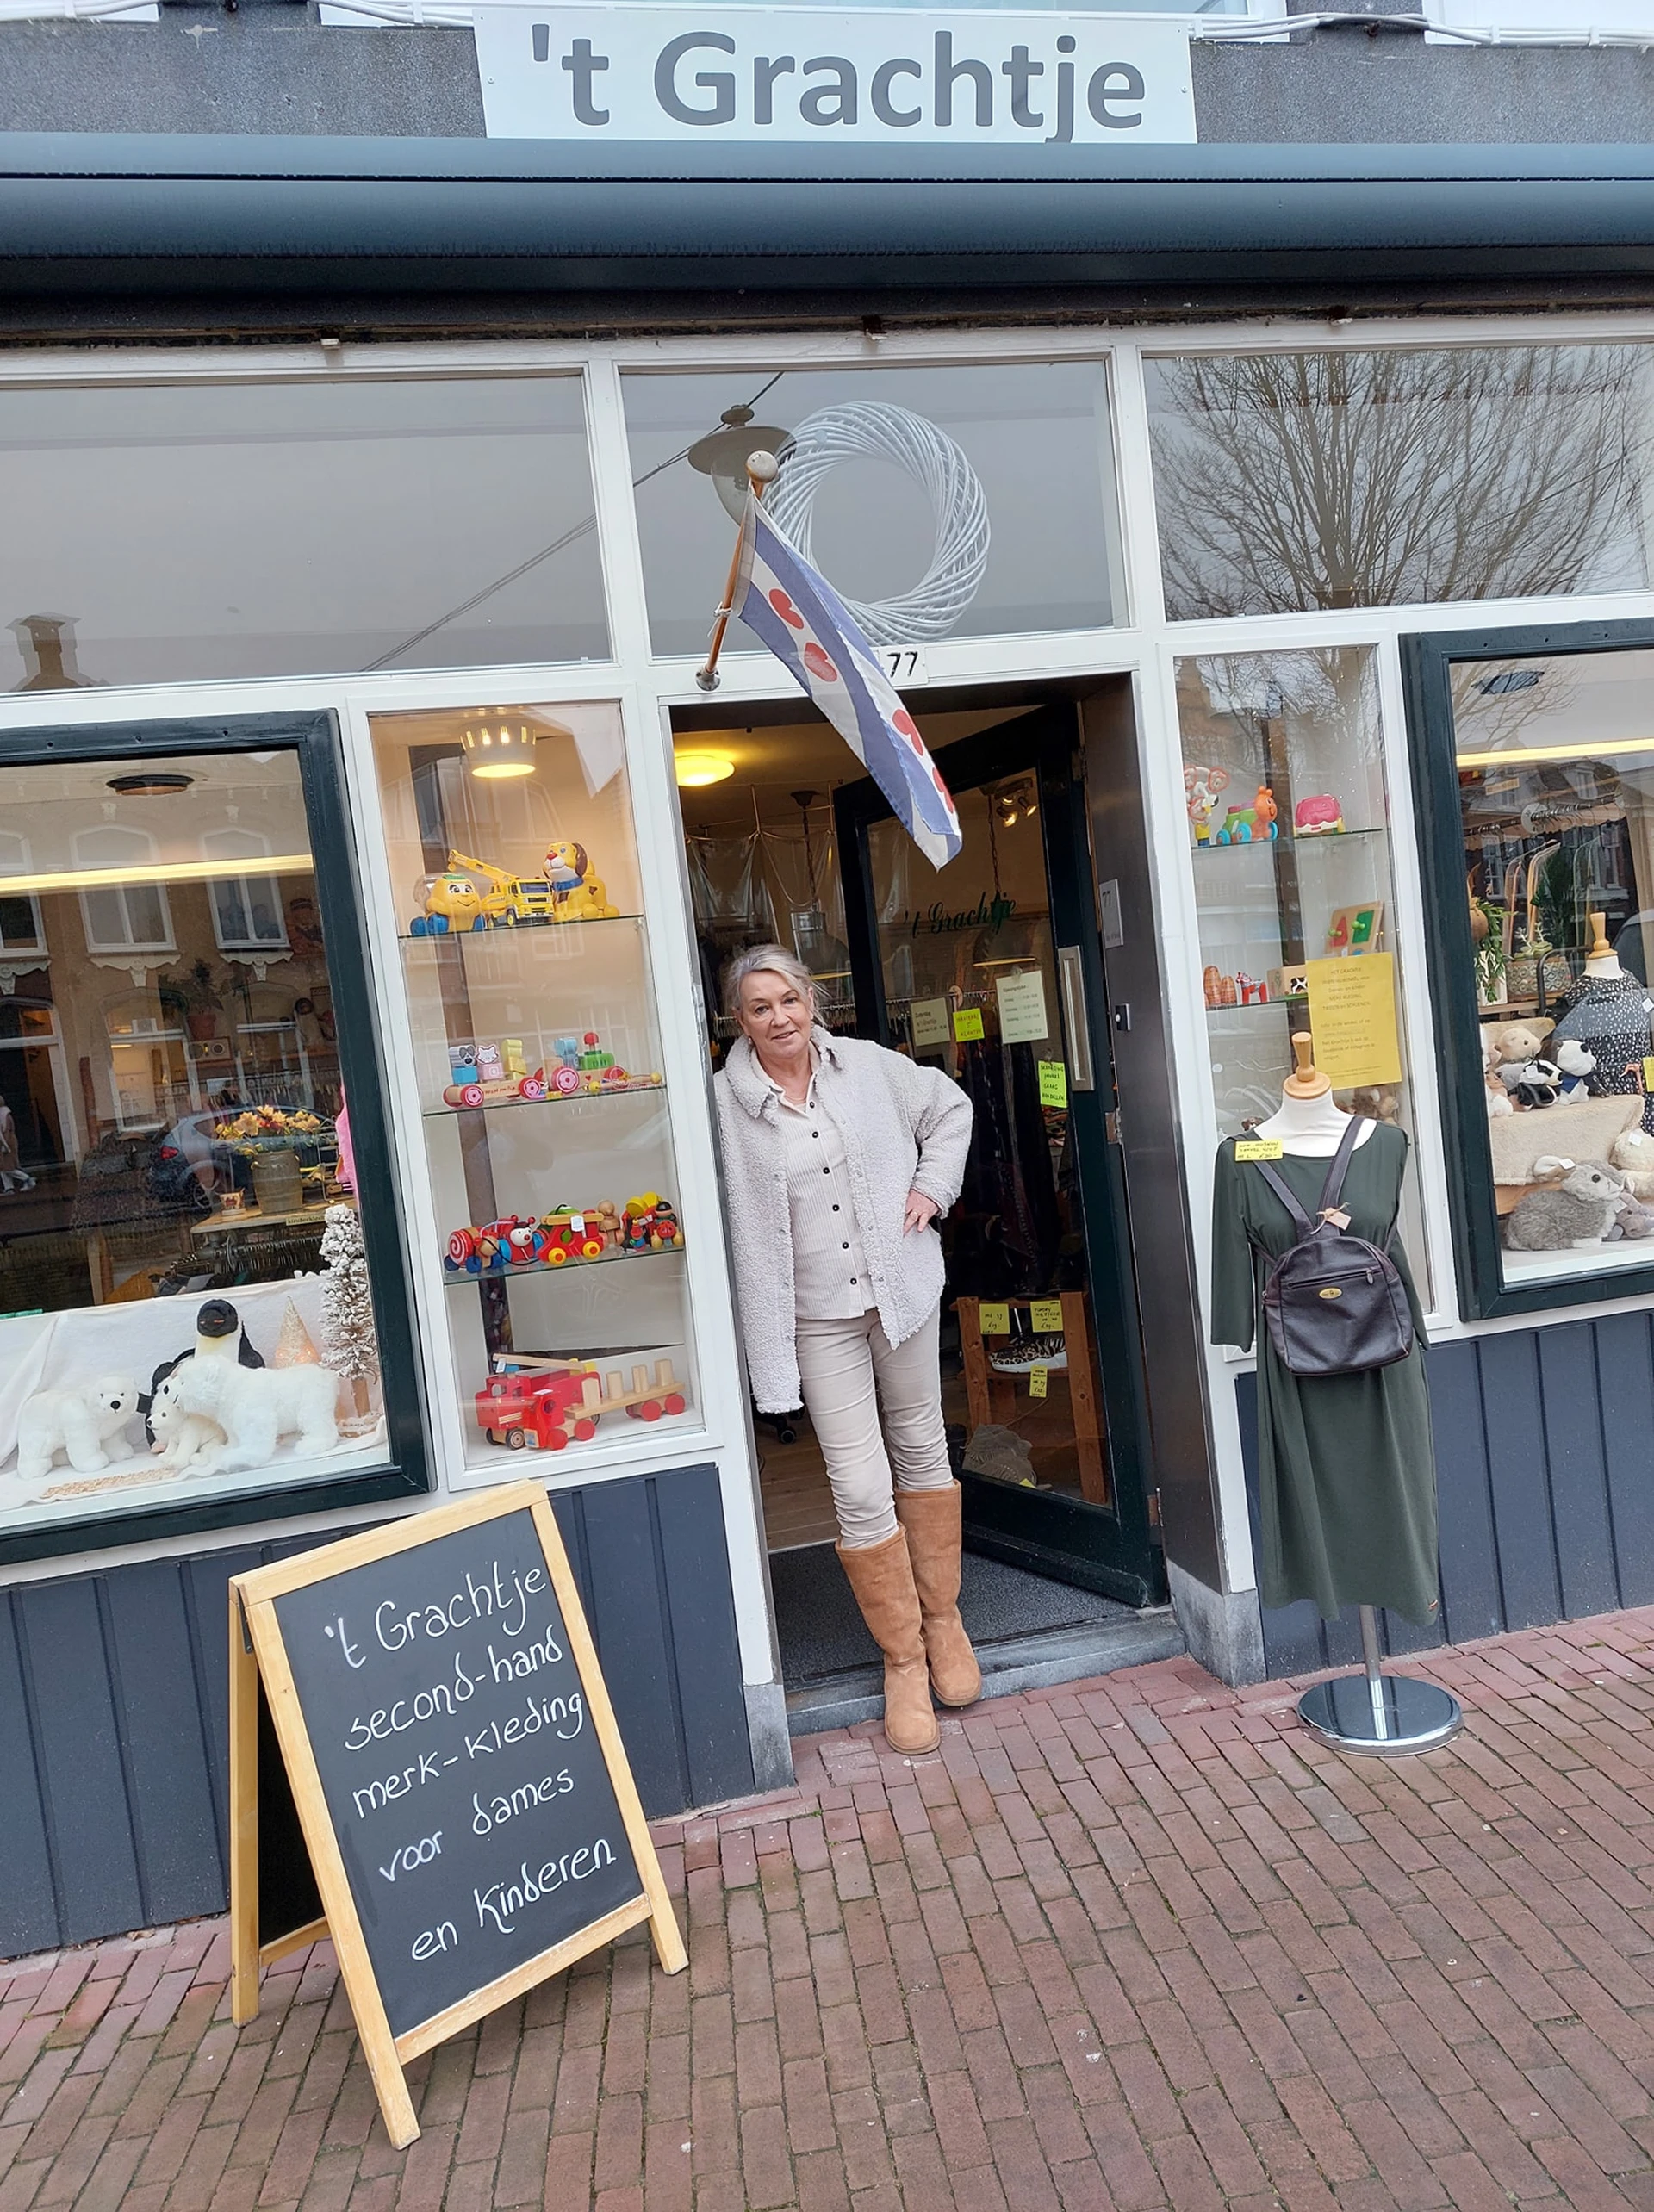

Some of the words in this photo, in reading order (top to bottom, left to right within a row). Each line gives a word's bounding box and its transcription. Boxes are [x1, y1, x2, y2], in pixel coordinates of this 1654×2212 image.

[531, 23, 611, 127] 't
[653, 30, 1146, 143] Grachtje
[886, 651, 918, 678] 77
[325, 1617, 366, 1668] 't
[374, 1561, 547, 1651] Grachtje
[344, 1624, 563, 1751] second-hand
[379, 1830, 443, 1882] voor
[471, 1768, 575, 1836] dames
[410, 1920, 458, 1960] en
